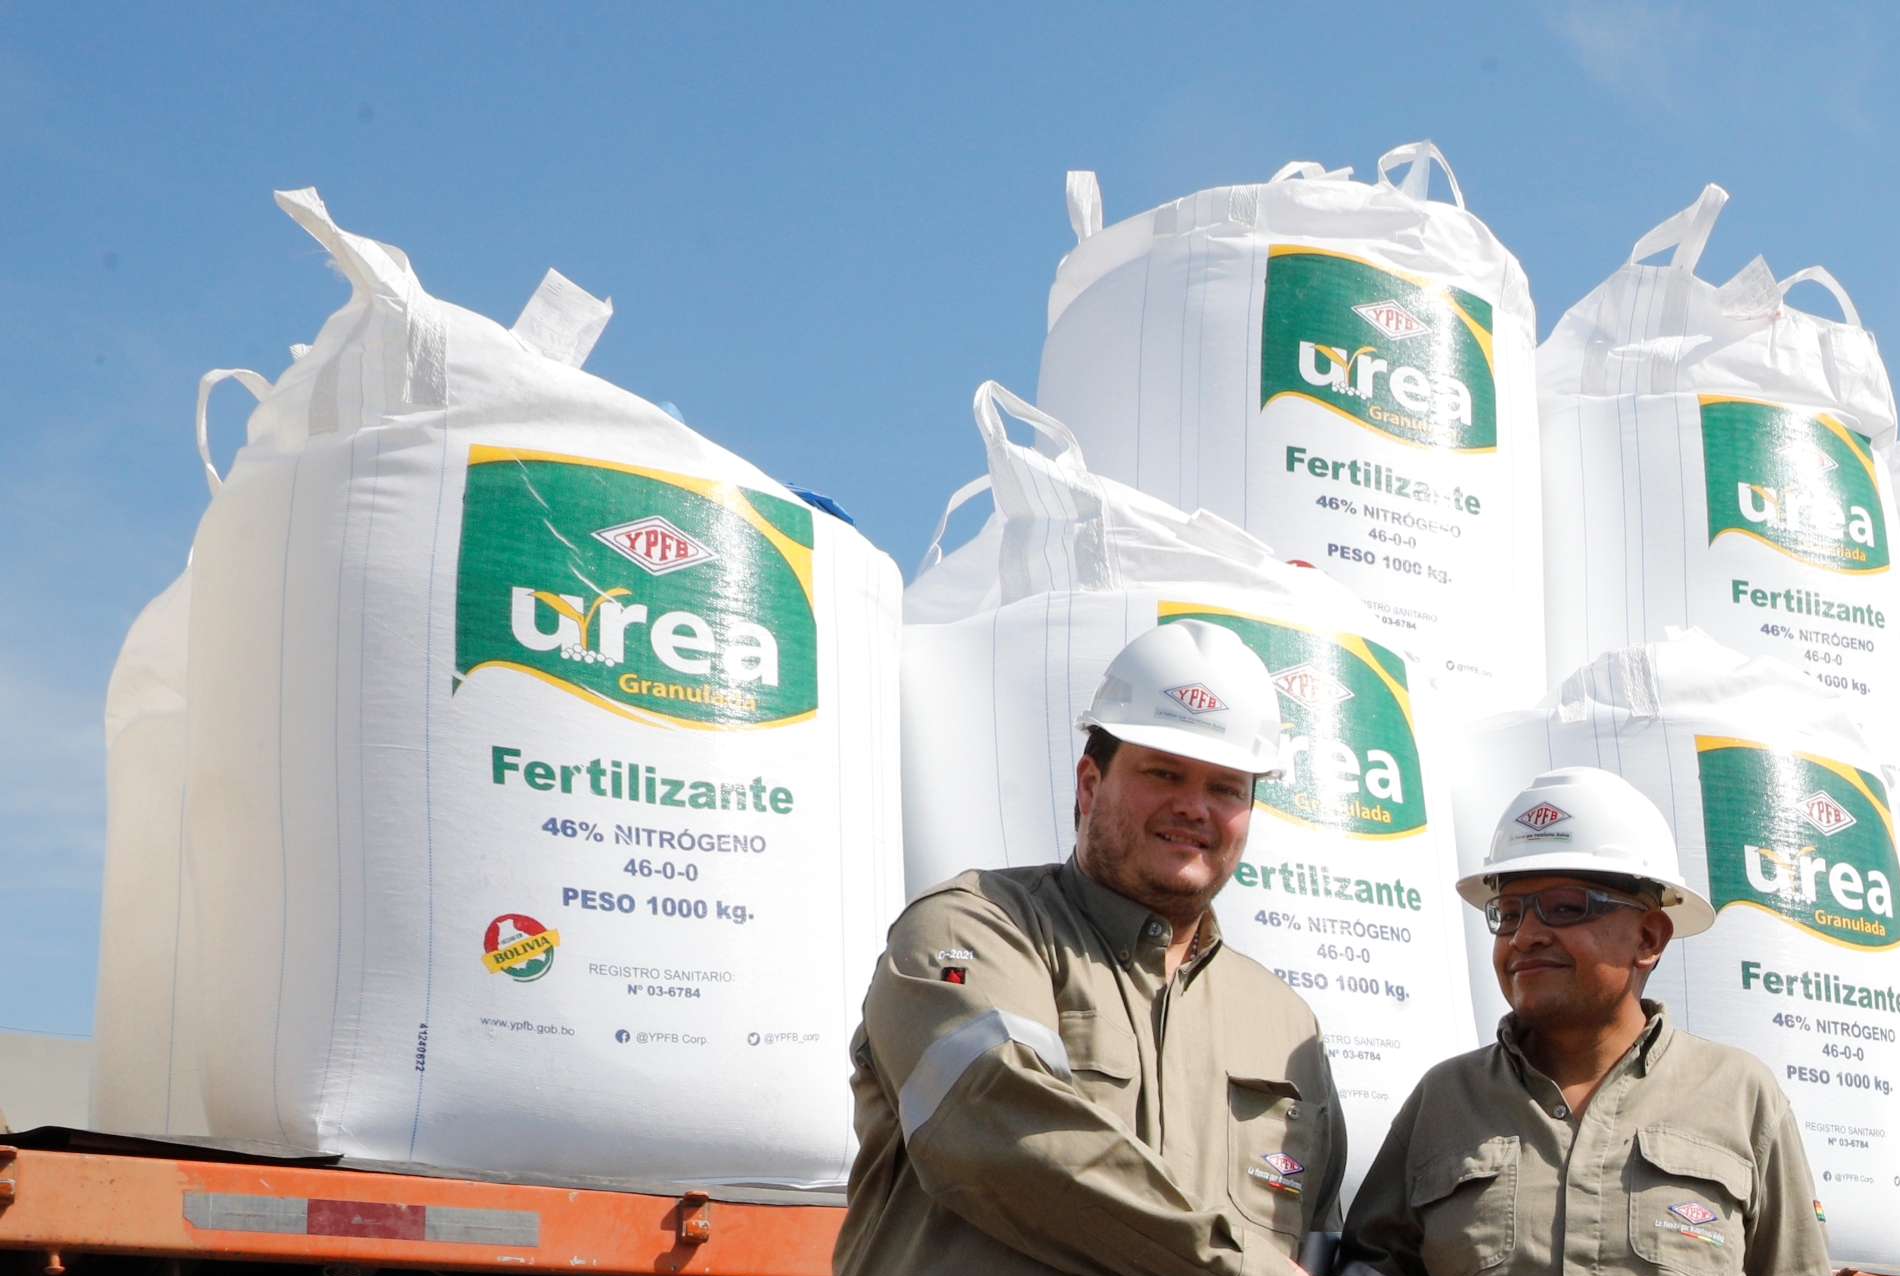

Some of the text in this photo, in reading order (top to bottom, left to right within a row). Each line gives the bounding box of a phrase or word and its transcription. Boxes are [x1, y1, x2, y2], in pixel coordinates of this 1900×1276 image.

[1299, 340, 1472, 426] urea
[1315, 495, 1357, 515] 46%
[1738, 482, 1875, 548] urea
[622, 520, 694, 561] YPFB
[1368, 528, 1417, 549] 46-0-0
[1327, 543, 1376, 565] PESO
[1383, 555, 1422, 575] 1000
[1731, 578, 1886, 629] Fertilizante
[511, 586, 779, 687] urea
[1382, 616, 1417, 630] 03-6784
[1760, 623, 1875, 653] 46% NITRÓGENO
[1804, 649, 1843, 666] 46-0-0
[1178, 688, 1217, 709] YPFB
[1851, 678, 1871, 695] kg.
[490, 745, 795, 815] Fertilizante
[1526, 807, 1558, 825] YPFB
[1804, 796, 1842, 827] YPFB
[541, 818, 767, 855] 46% NITRÓGENO
[623, 857, 699, 882] 46-0-0
[1742, 844, 1894, 919] urea
[1233, 860, 1423, 911] ertilizante
[562, 887, 755, 924] PESO 1000 kg.
[1254, 910, 1412, 943] 46% NITRÓGENO
[1815, 909, 1886, 937] Granulada
[493, 936, 551, 964] BOLIVIA
[1316, 943, 1371, 964] 46-0-0
[589, 963, 736, 983] REGISTRO SANITARIO:
[647, 985, 701, 999] 03-6784
[1335, 975, 1380, 995] 1000
[1385, 980, 1410, 1001] kg.
[480, 1016, 576, 1037] www.ypfb.gob.bo
[636, 1032, 679, 1044] @YPFB
[764, 1032, 821, 1045] @YPFB_corp
[1772, 1012, 1896, 1043] 46% NITRÓGENO
[1342, 1049, 1381, 1061] 03-6784
[1821, 1043, 1865, 1061] 46-0-0
[1786, 1065, 1893, 1094] PESO 1000 kg.
[1805, 1122, 1847, 1134] REGISTRO
[1839, 1138, 1869, 1149] 03-6784
